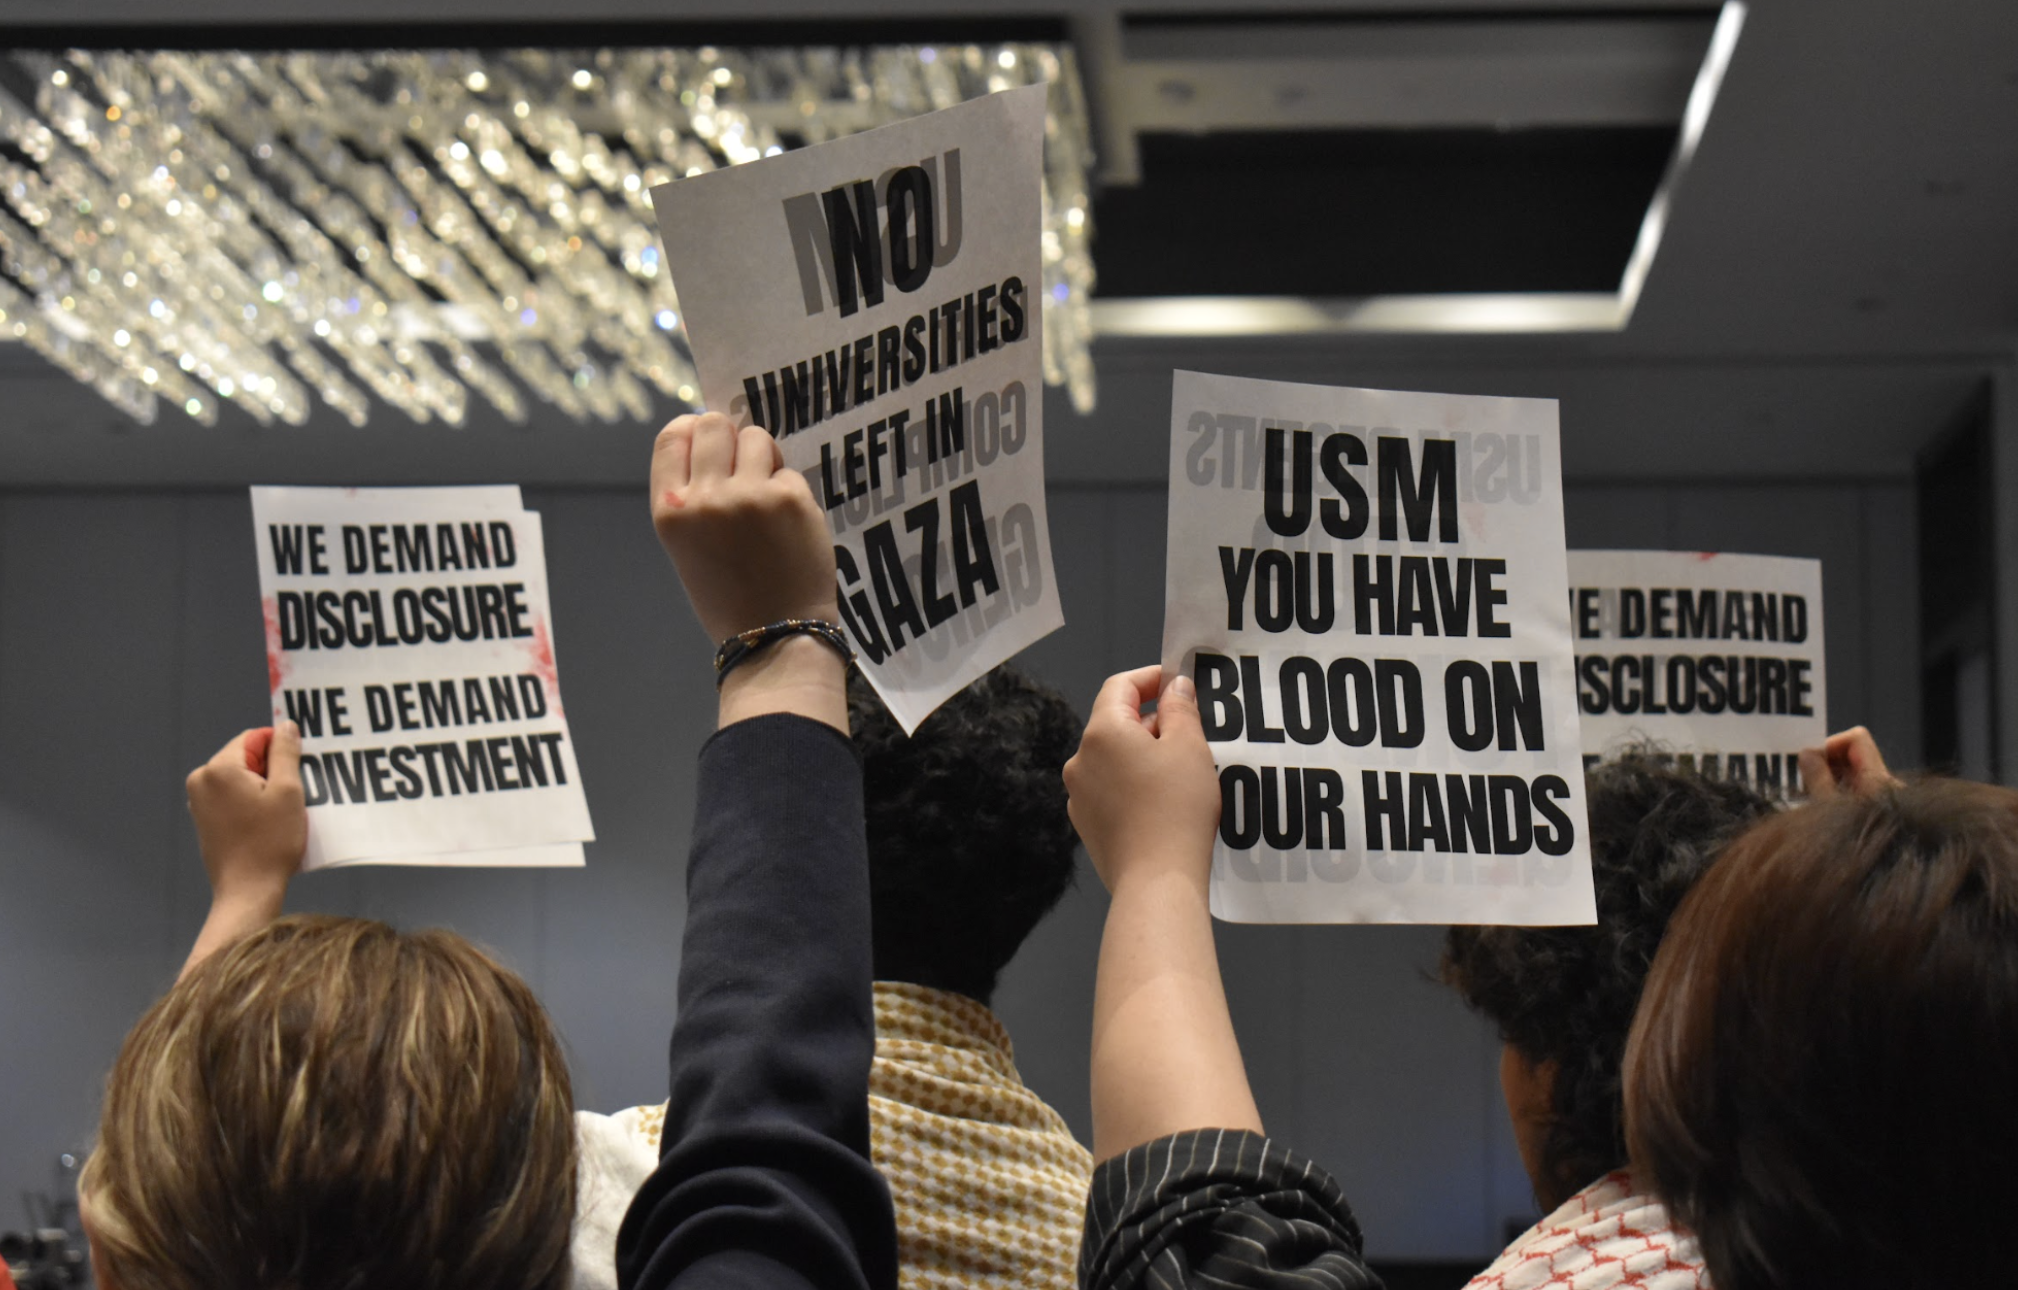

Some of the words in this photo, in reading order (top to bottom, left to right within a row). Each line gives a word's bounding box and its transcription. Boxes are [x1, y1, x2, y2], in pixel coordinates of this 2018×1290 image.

[821, 166, 934, 318] NO
[743, 276, 1024, 439] UNIVERSITIES
[820, 409, 910, 511] LEFT
[926, 386, 965, 464] IN
[1264, 428, 1459, 543] USM
[269, 524, 330, 575] WE
[342, 521, 516, 576] DEMAND
[833, 479, 1000, 665] GAZA
[1218, 546, 1335, 634] YOU
[1353, 554, 1512, 638] HAVE
[276, 582, 534, 651] DISCLOSURE
[1568, 587, 1601, 639] E
[1619, 587, 1808, 643] DEMAND
[284, 688, 352, 738] WE
[364, 674, 547, 733] DEMAND
[1194, 652, 1425, 749] BLOOD
[1444, 659, 1545, 752] ON
[299, 732, 568, 807] DIVESTMENT
[1213, 764, 1346, 850] OUR
[1361, 770, 1575, 856] HANDS
